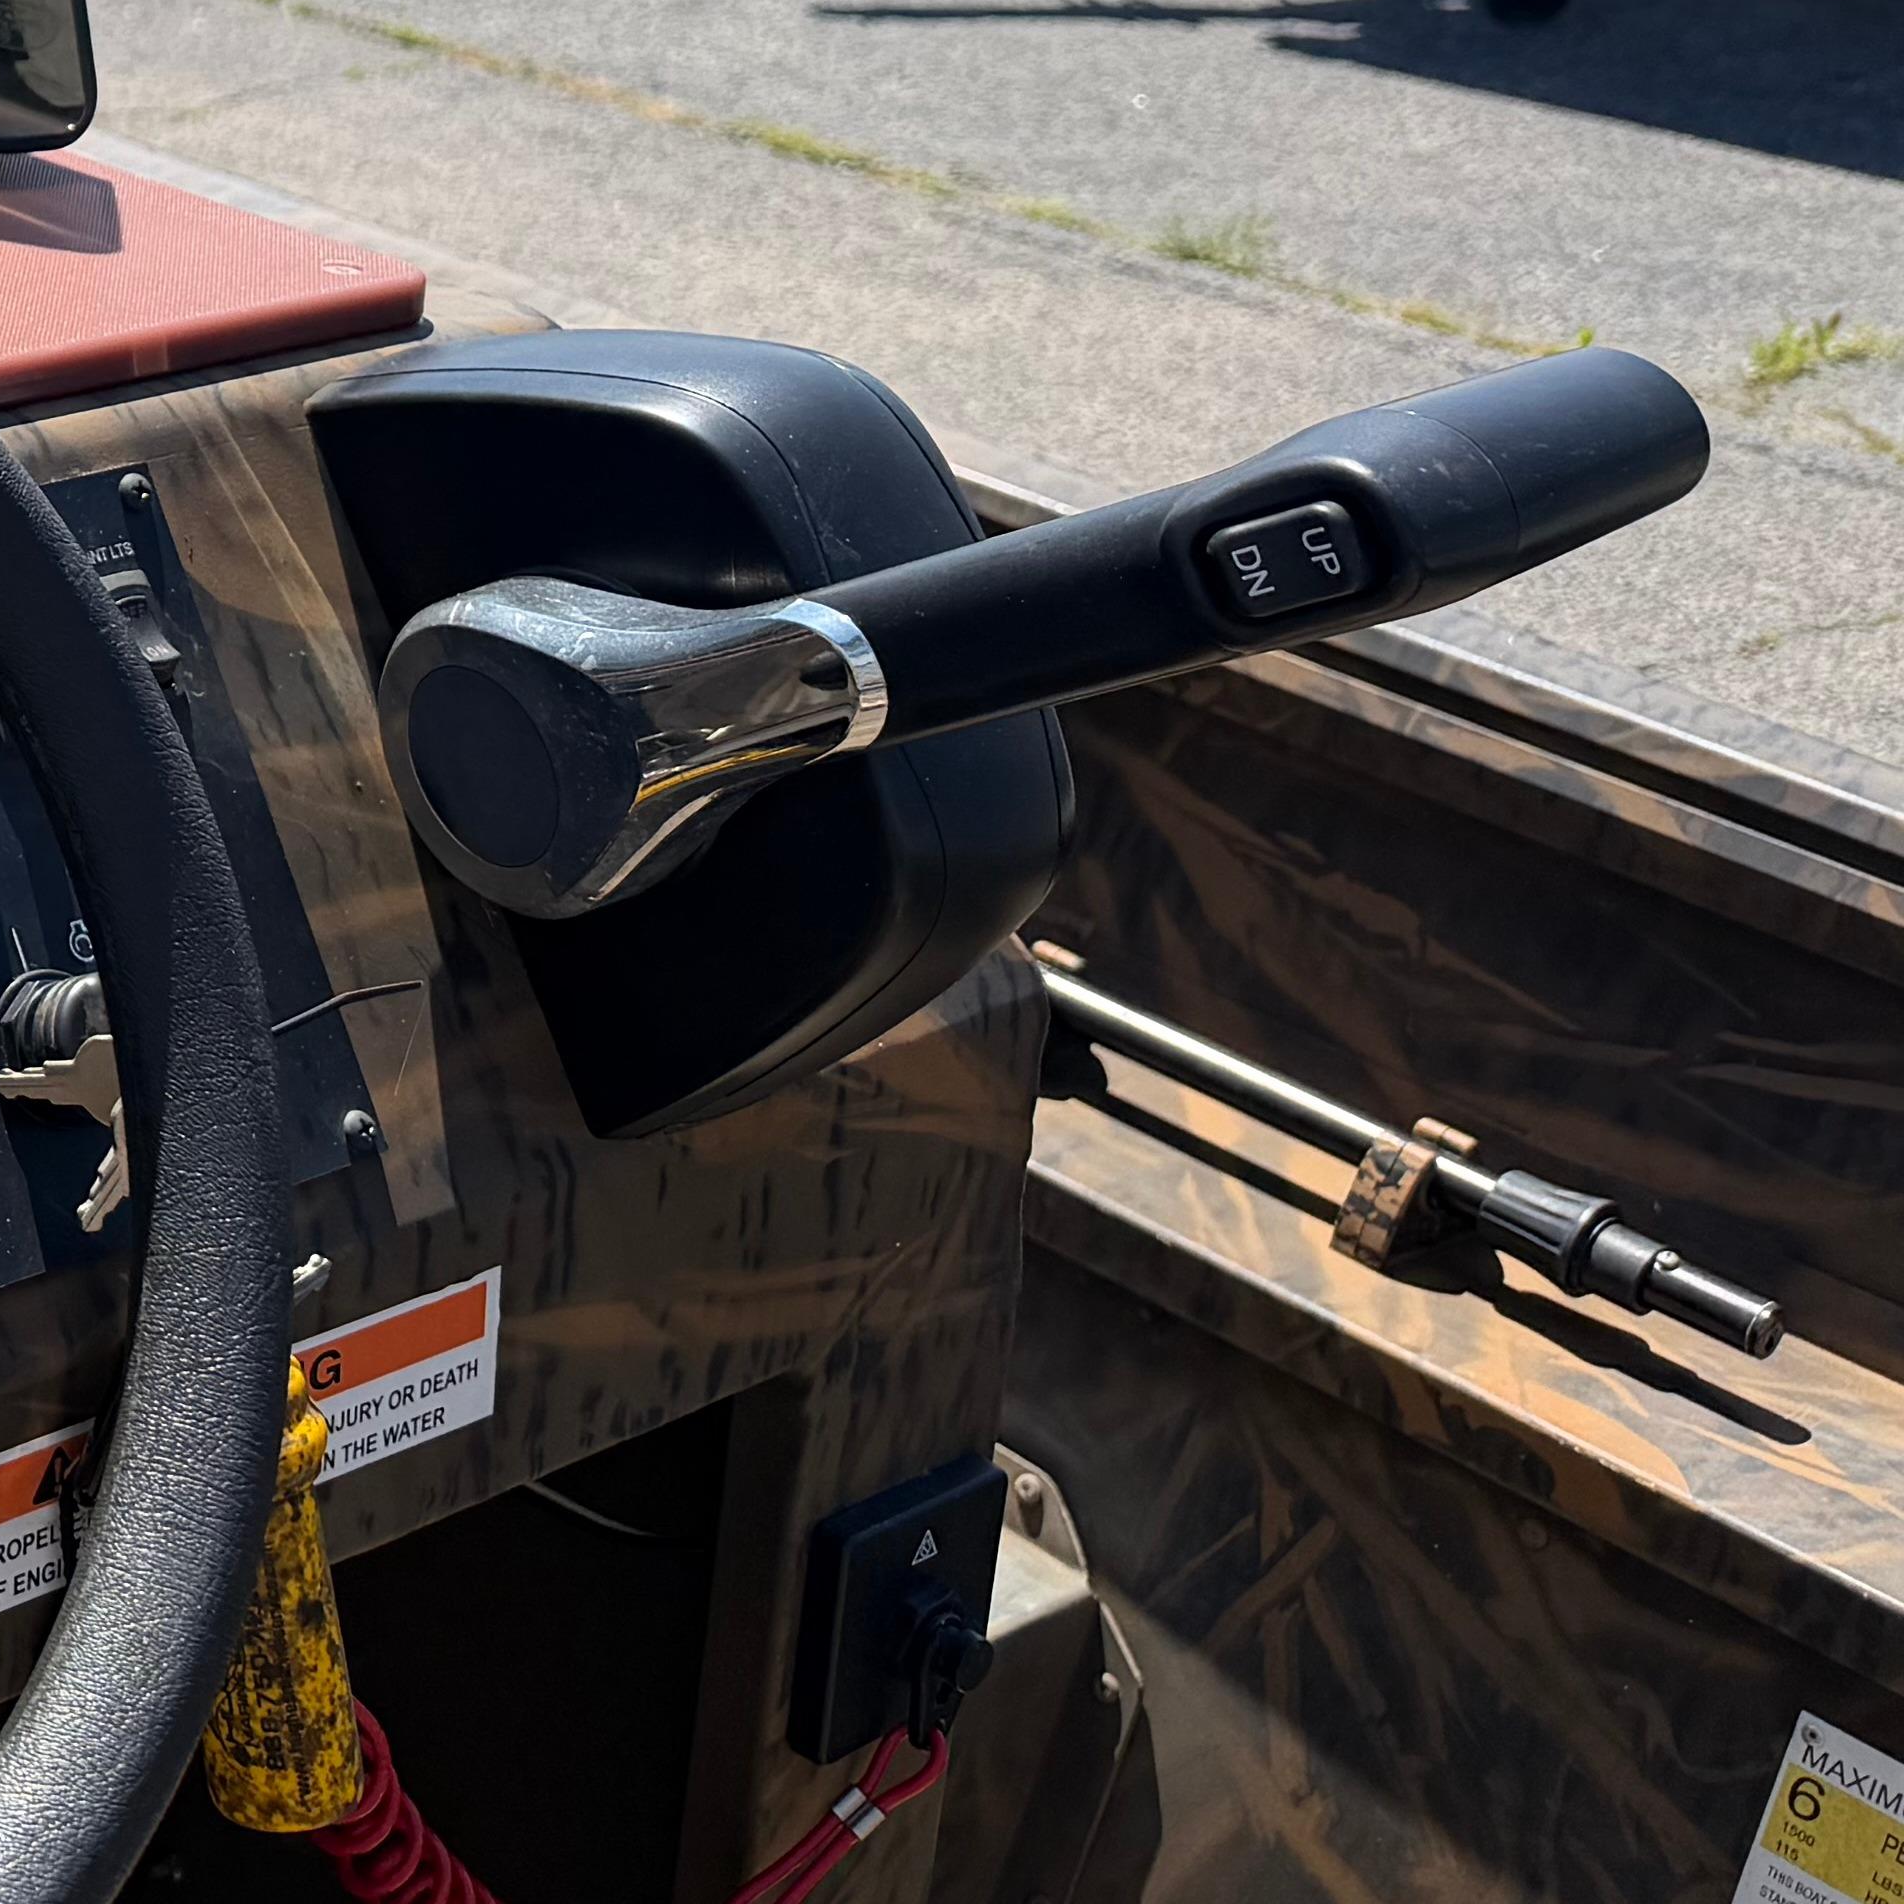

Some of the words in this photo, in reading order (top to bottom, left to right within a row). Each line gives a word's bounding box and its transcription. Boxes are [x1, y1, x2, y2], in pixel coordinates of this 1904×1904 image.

[87, 546, 109, 564] NT
[110, 541, 135, 559] LTS
[1231, 544, 1276, 597] DN
[1301, 526, 1341, 575] UP
[146, 643, 169, 658] ON
[327, 1395, 384, 1434] NJURY
[388, 1384, 414, 1410] OR
[420, 1358, 479, 1399] DEATH
[323, 1449, 336, 1472] N
[342, 1432, 378, 1464] THE
[382, 1406, 445, 1449] WATER
[13, 1558, 63, 1596] ENGI
[1788, 1777, 1825, 1822] 6
[1802, 1745, 1904, 1815] MAXIM
[1768, 1864, 1794, 1889] THIS
[1795, 1881, 1828, 1904] BOAT
[1872, 1870, 1903, 1897] LBS
